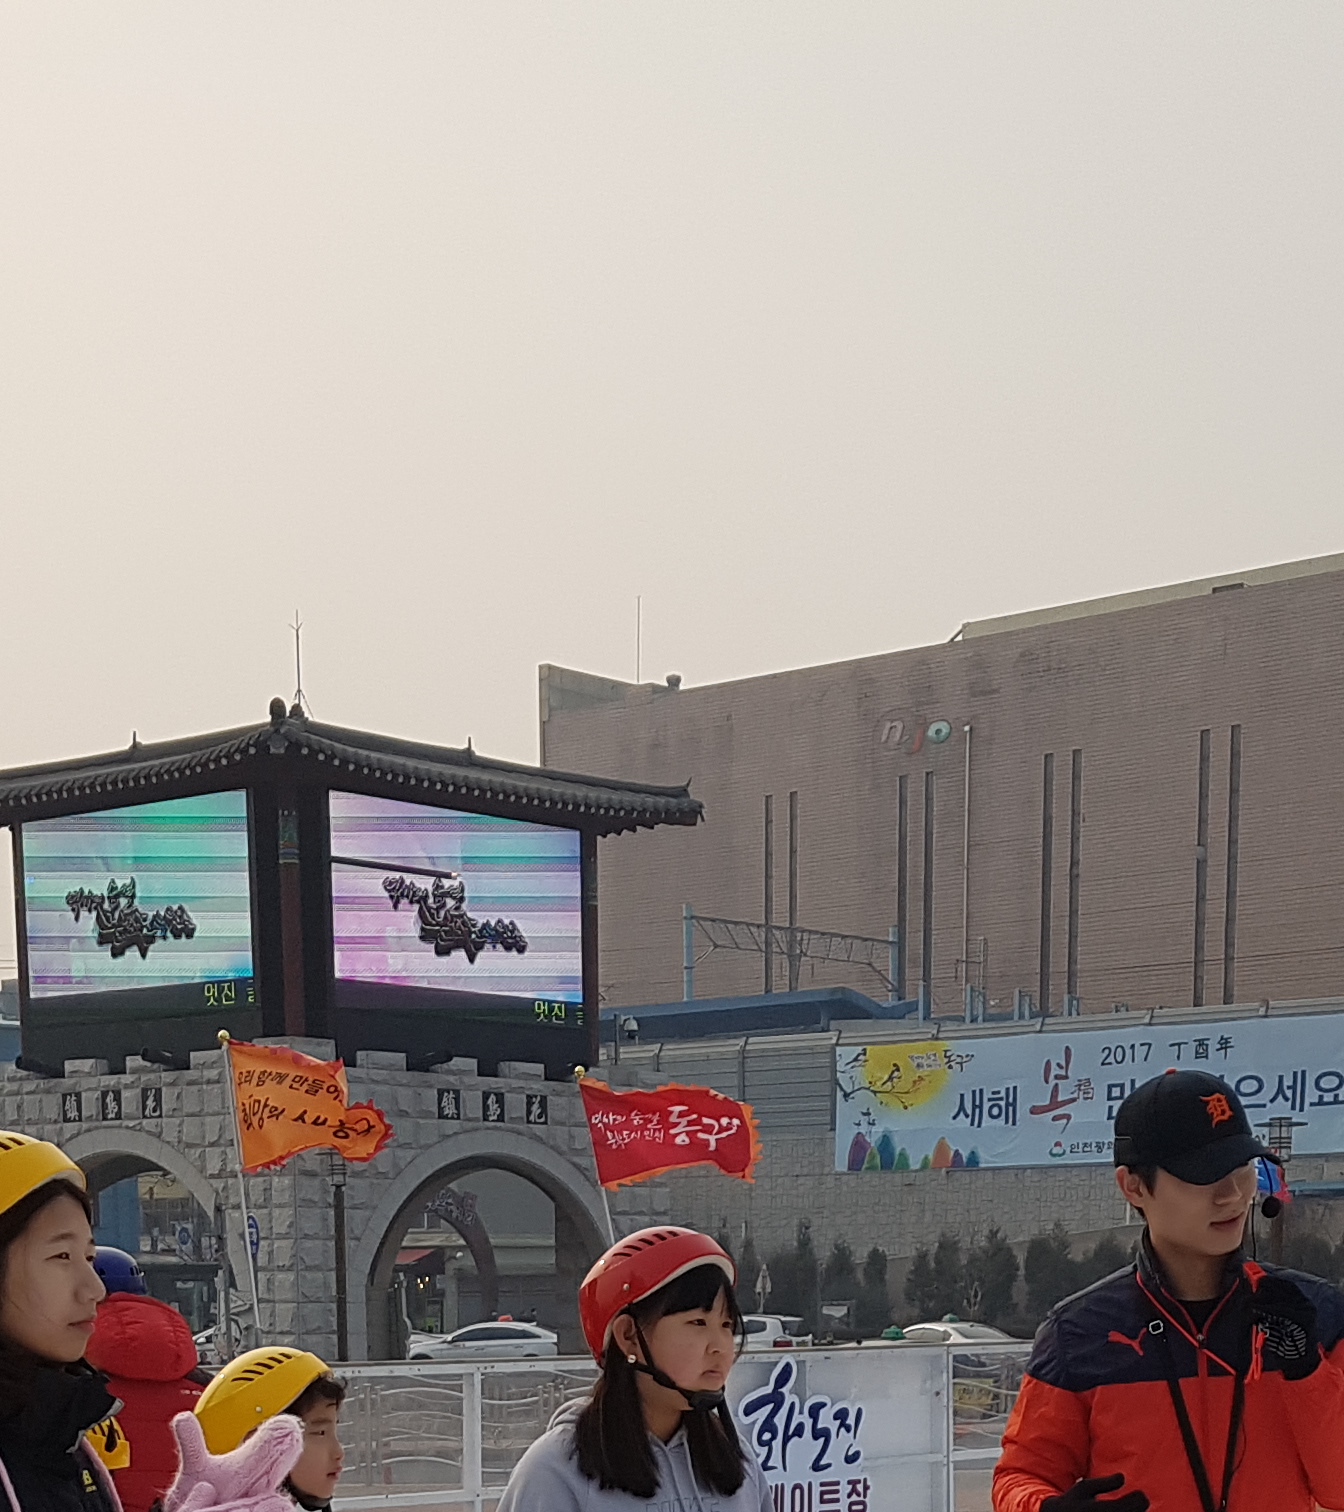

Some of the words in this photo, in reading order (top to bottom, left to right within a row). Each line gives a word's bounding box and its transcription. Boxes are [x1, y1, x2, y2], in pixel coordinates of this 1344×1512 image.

[204, 981, 236, 1006] 멋진
[534, 1000, 566, 1024] 멋진
[1100, 1042, 1153, 1066] 2017
[256, 1069, 289, 1087] 함께
[952, 1085, 1020, 1128] 새해
[666, 1105, 742, 1150] 동구
[743, 1361, 864, 1473] 화도진
